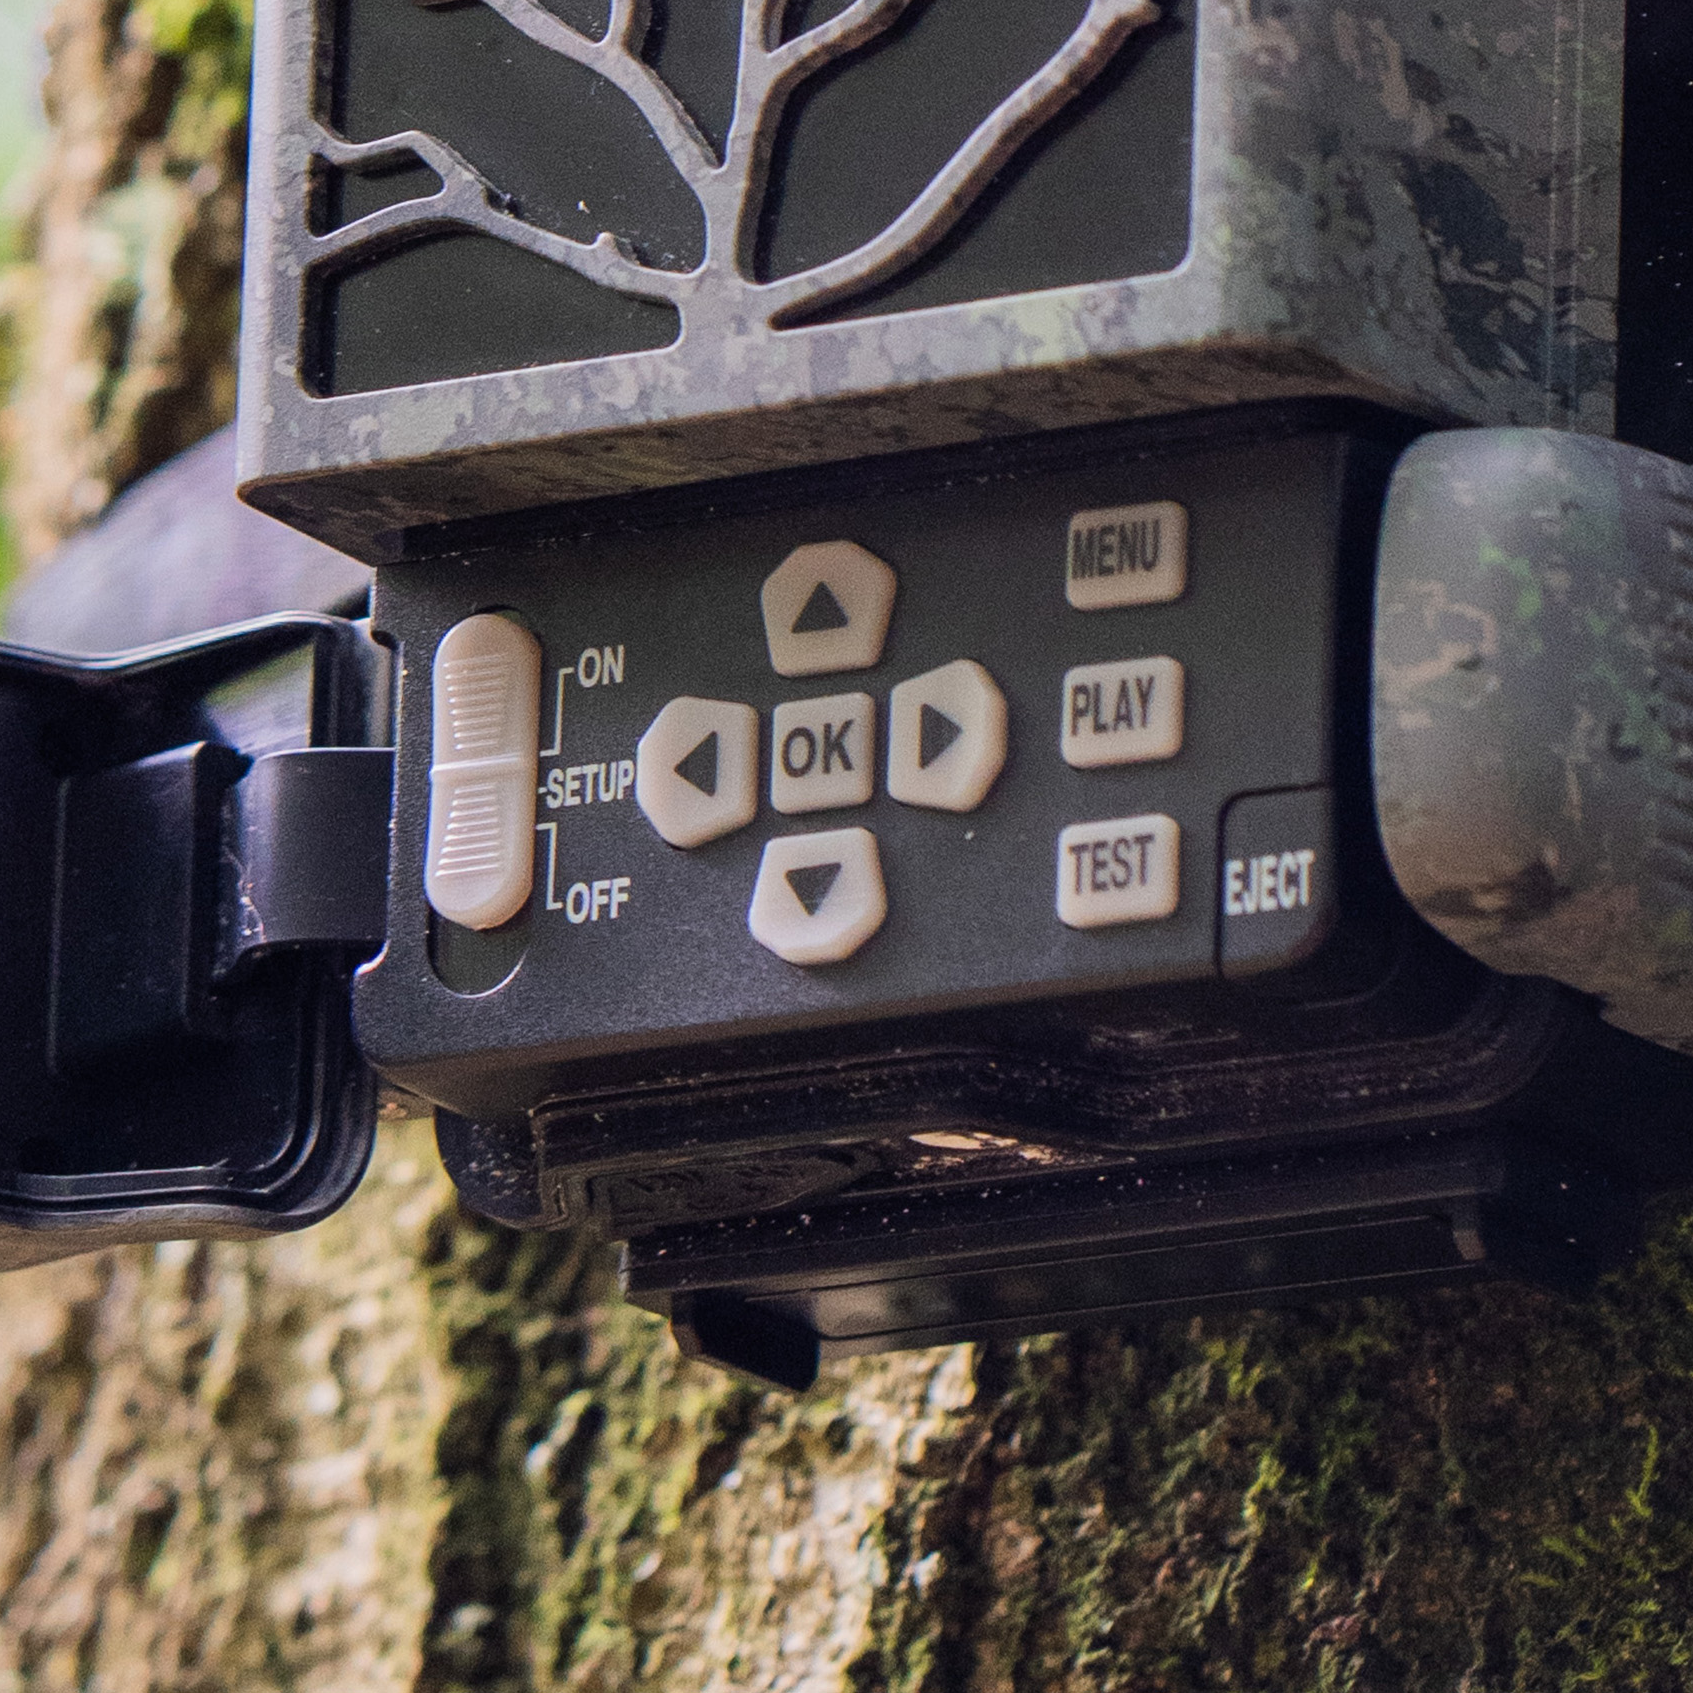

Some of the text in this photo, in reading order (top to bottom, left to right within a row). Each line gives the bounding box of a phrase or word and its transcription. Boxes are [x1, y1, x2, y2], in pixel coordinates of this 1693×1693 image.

[1071, 520, 1161, 580] MENU
[577, 644, 625, 688] ON
[1070, 676, 1155, 737] PLAY
[780, 719, 855, 778] OK
[545, 759, 636, 809] SETUP
[1068, 834, 1155, 894] TEST
[1224, 849, 1316, 915] EJECT
[565, 877, 631, 924] OFF
